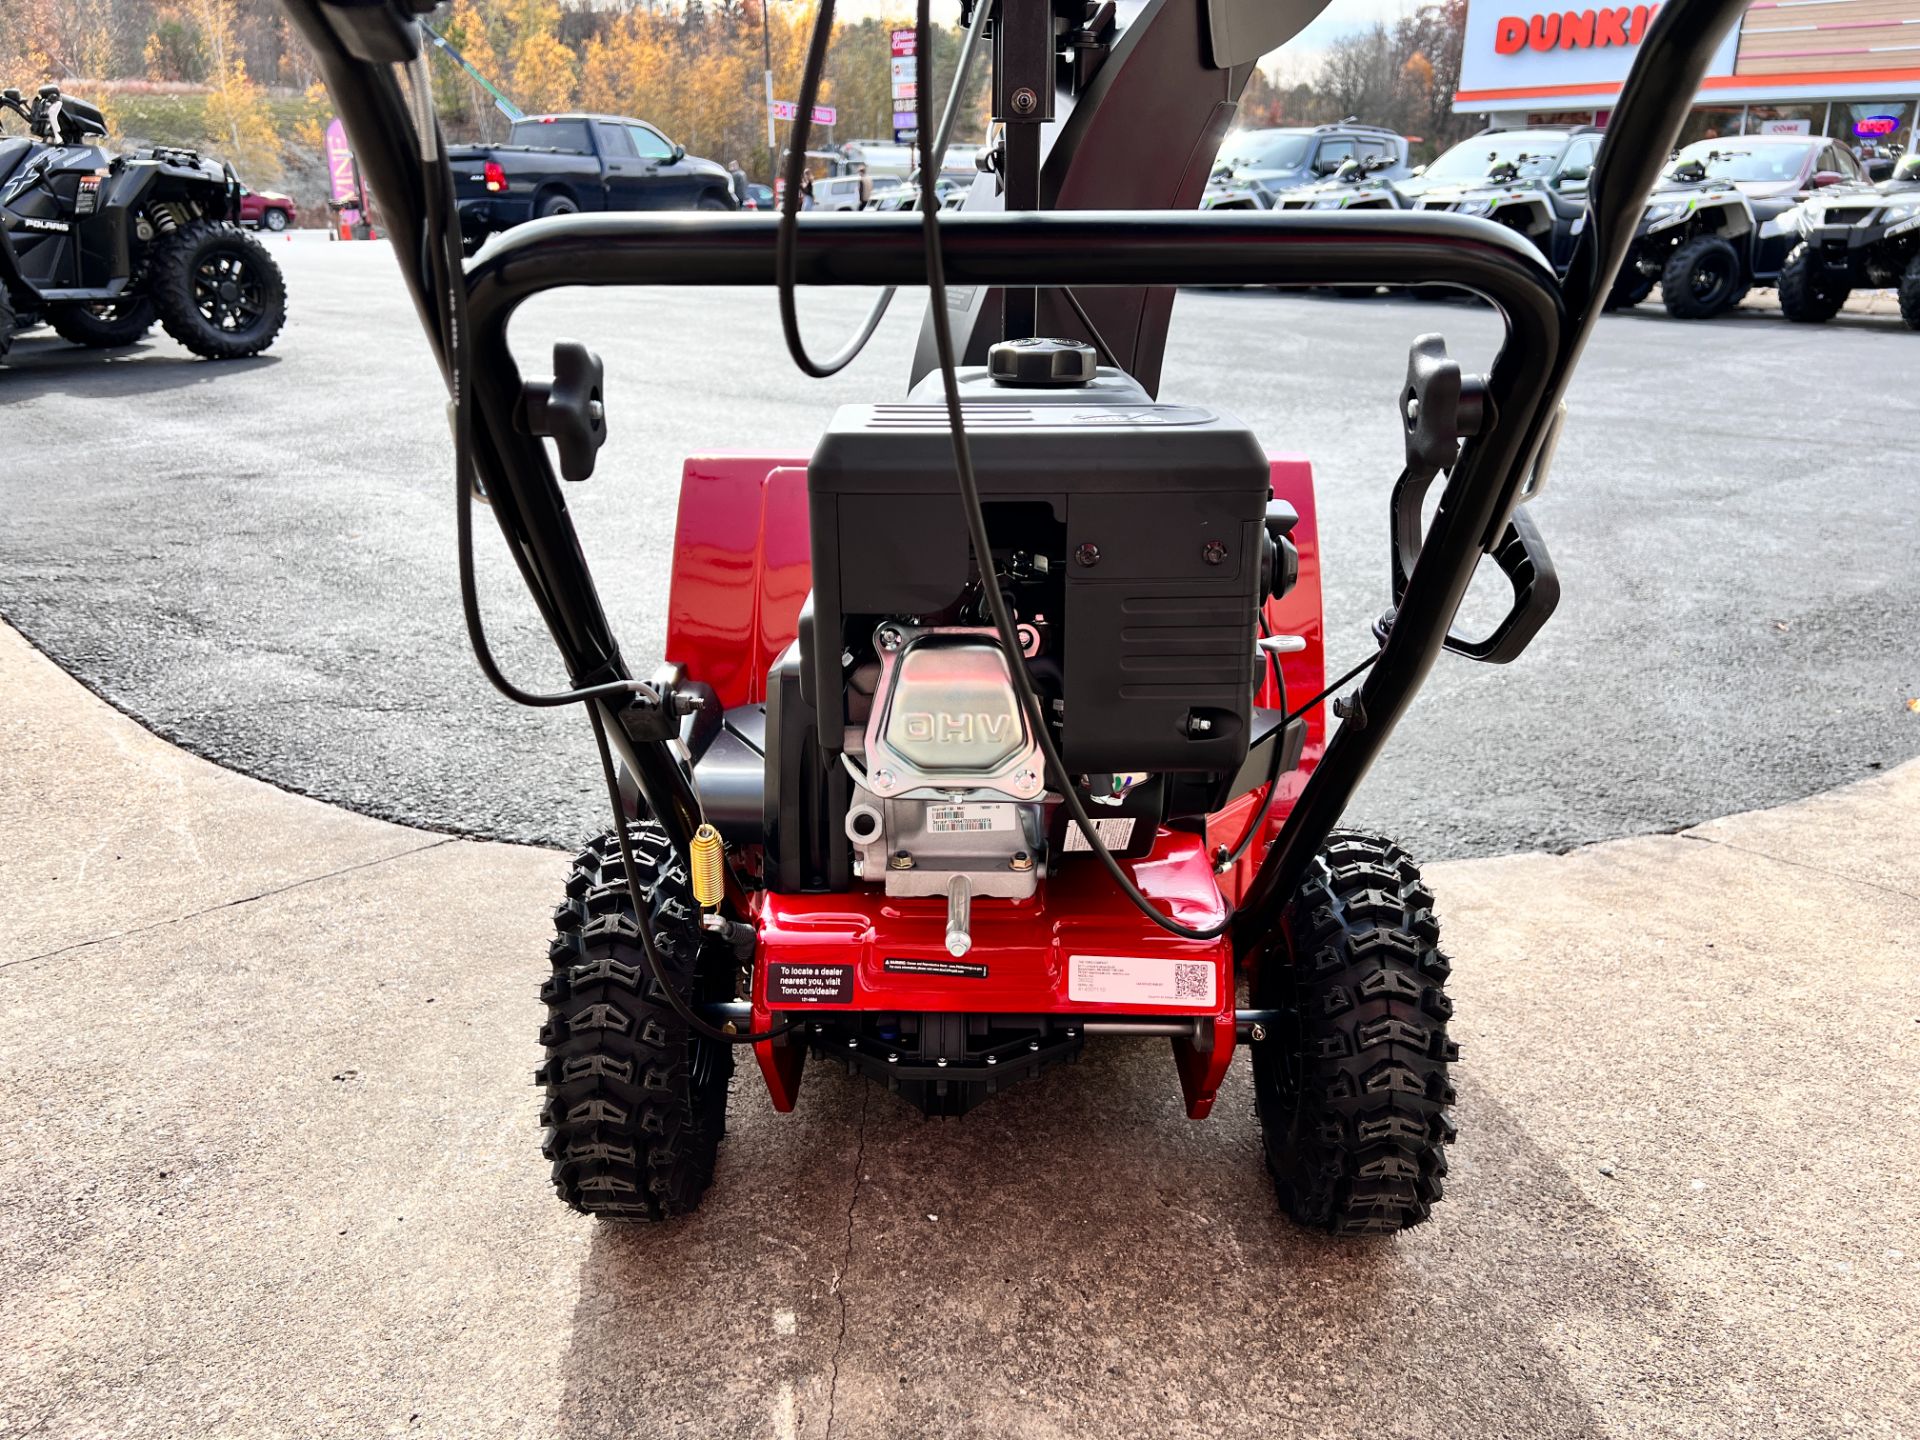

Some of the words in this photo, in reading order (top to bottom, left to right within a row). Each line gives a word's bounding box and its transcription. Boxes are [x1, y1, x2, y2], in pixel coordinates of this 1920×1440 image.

[1857, 119, 1895, 134] OPEN
[25, 219, 69, 231] POLARIS
[902, 712, 1011, 742] OHV
[781, 966, 789, 975] To
[791, 967, 813, 975] locate
[820, 967, 843, 976] dealer
[780, 977, 807, 985] nearest
[808, 978, 824, 987] you,
[825, 977, 841, 986] visit
[781, 986, 839, 995] Toro.com/dealer
